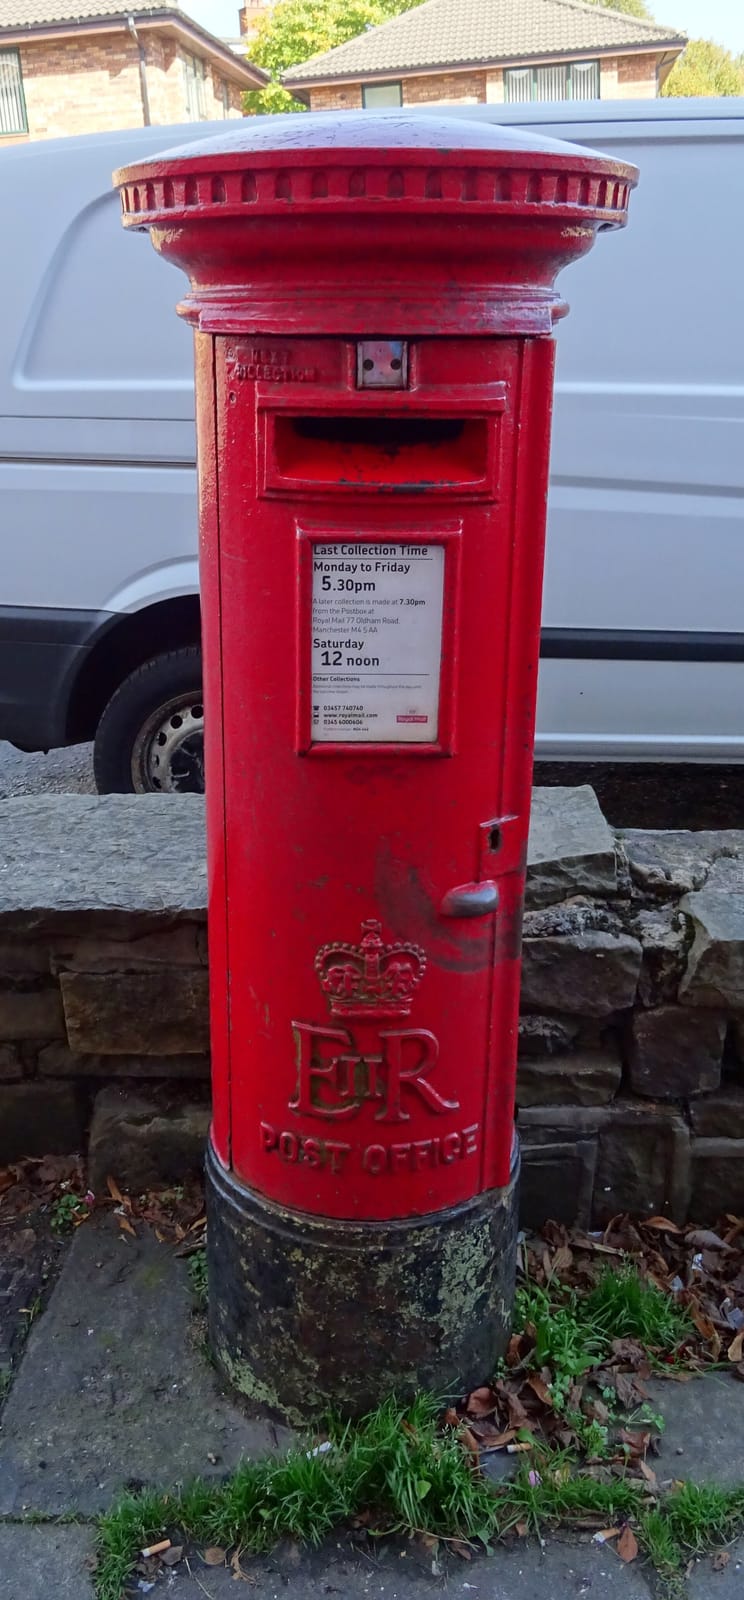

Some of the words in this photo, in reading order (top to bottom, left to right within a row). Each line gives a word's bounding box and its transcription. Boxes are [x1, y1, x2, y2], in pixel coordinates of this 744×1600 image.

[313, 545, 338, 556] Last
[341, 545, 397, 556] Collection
[399, 545, 428, 556] Time
[313, 561, 358, 574] Monday
[360, 562, 372, 573] to
[375, 562, 411, 574] Friday
[321, 575, 376, 593] 5.30pm
[399, 598, 426, 606] 7.30pm
[313, 617, 331, 625] Royal
[313, 638, 364, 650] Saturday
[321, 651, 343, 666] 12
[346, 656, 380, 666] noon
[259, 1120, 351, 1175] POST
[363, 1122, 479, 1175] OFFICE
